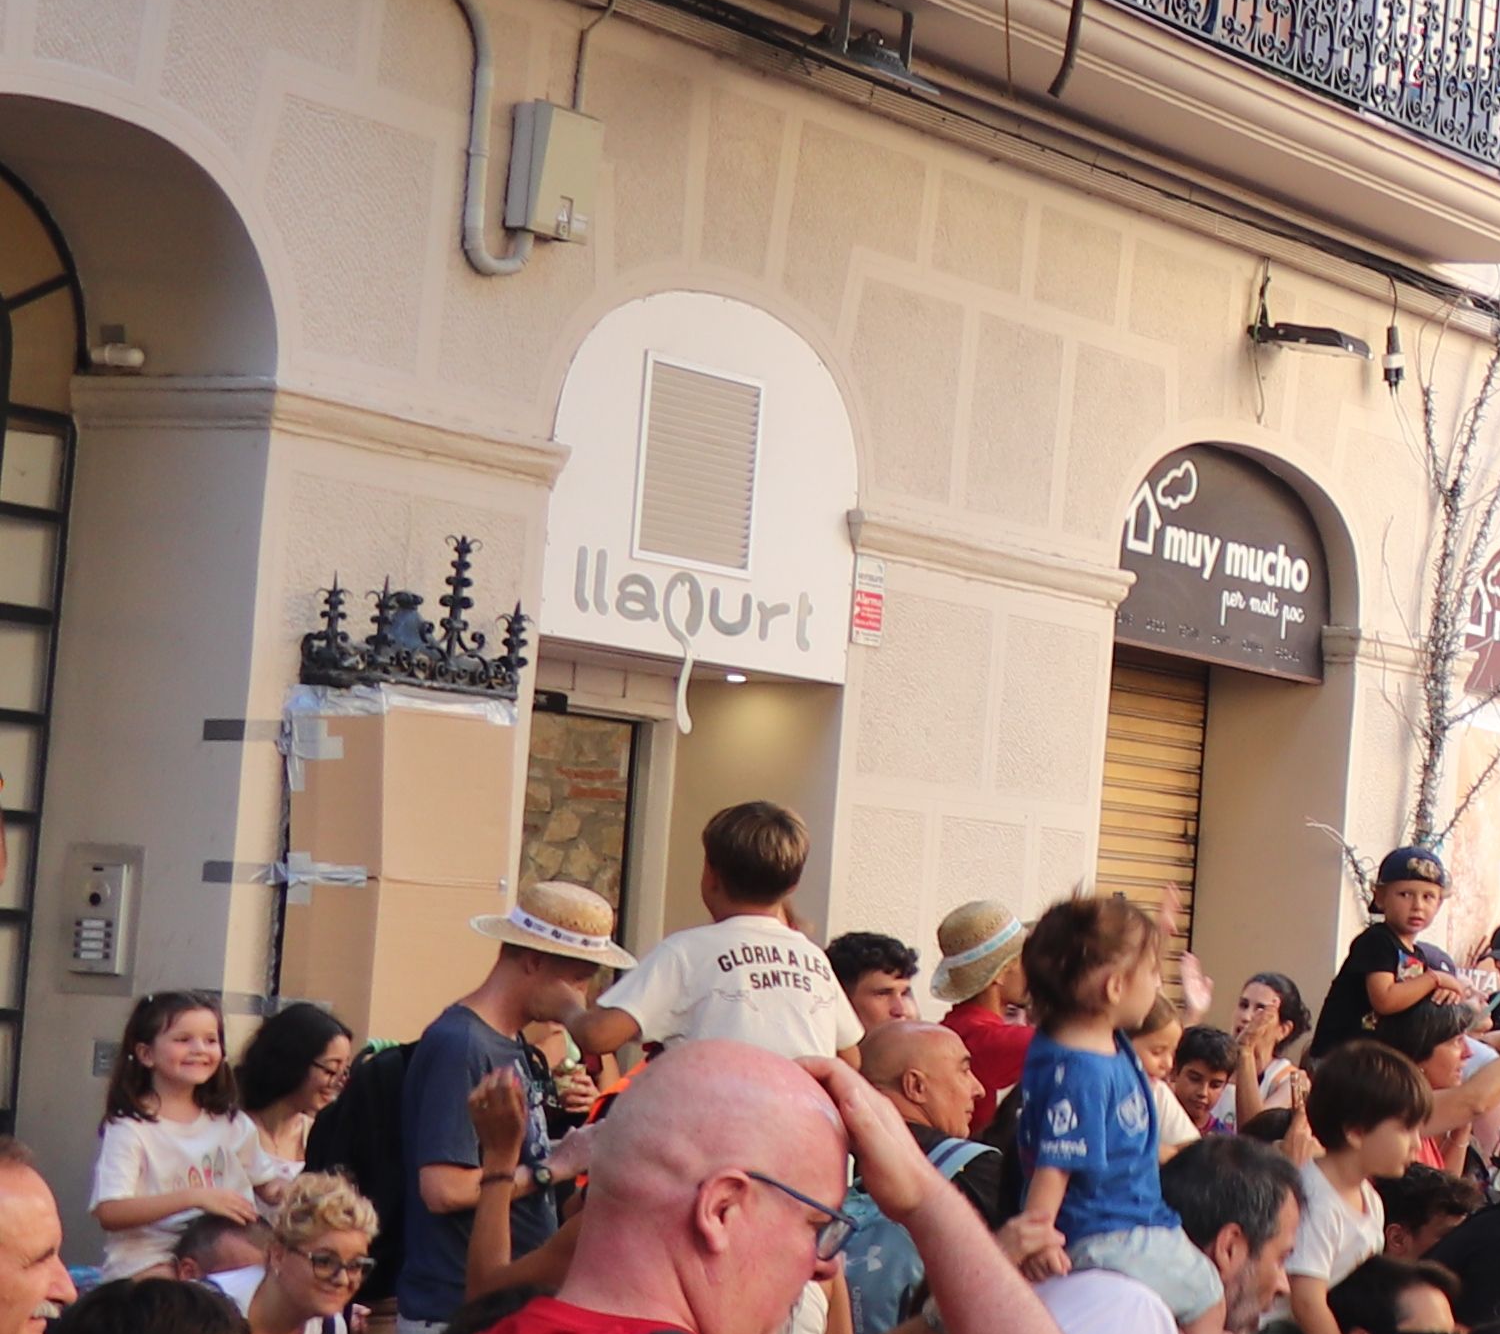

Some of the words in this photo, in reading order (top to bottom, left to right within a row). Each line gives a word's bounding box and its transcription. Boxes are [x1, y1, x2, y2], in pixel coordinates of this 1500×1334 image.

[1162, 525, 1221, 581] muy
[1224, 542, 1310, 593] mucho
[1220, 590, 1247, 627] per
[1249, 591, 1279, 618] molt
[1279, 606, 1305, 640] poc
[718, 942, 783, 974] GLÒRIA
[787, 945, 800, 967] A
[803, 953, 832, 983] LES
[749, 972, 813, 993] SANTES
